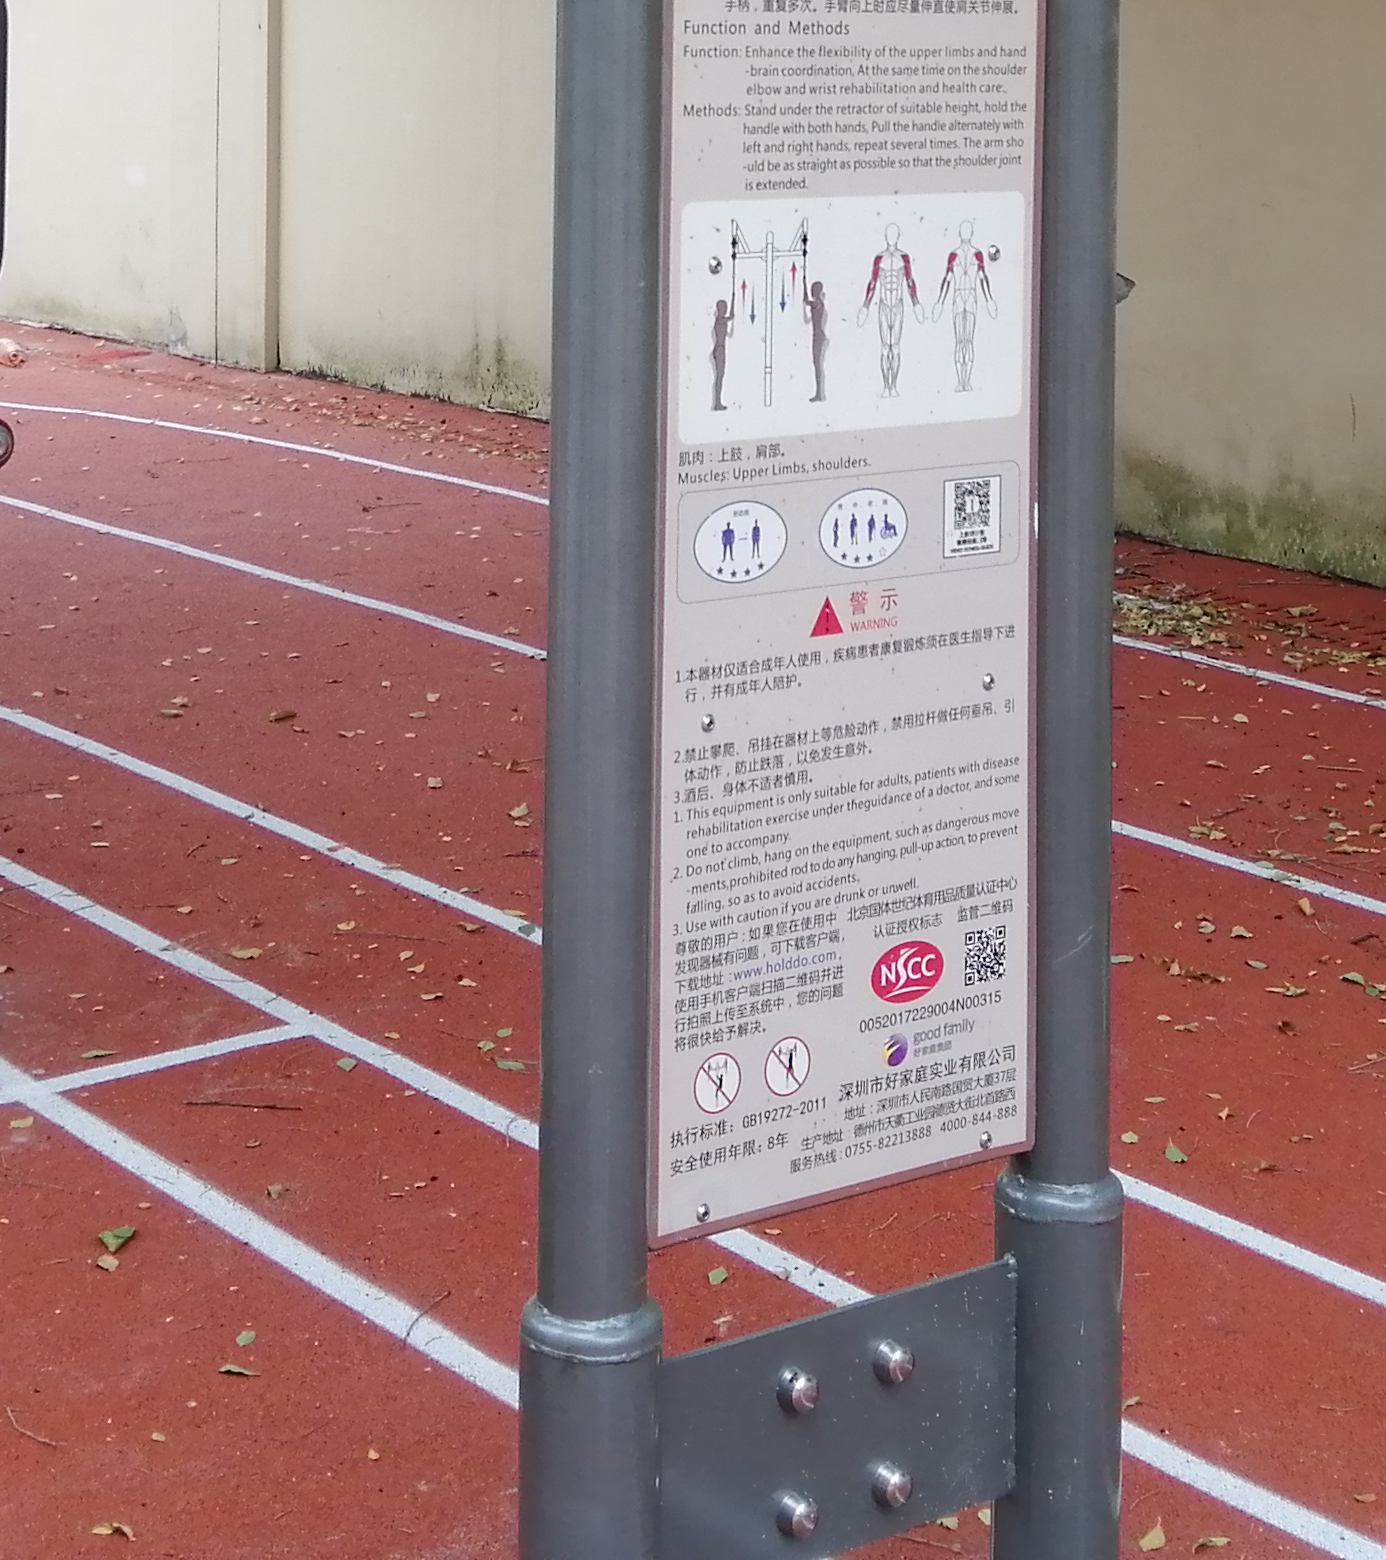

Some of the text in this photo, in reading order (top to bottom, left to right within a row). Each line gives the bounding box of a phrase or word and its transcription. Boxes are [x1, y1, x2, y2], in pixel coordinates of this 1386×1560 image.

[683, 19, 849, 35] Function and Methods
[683, 44, 1026, 60] Function: Enhance the flexibility of the upper limbs and hand
[857, 64, 870, 76] At
[871, 64, 888, 76] the
[891, 66, 919, 76] same
[921, 62, 945, 75] time
[946, 66, 960, 75] on
[962, 63, 980, 75] the
[981, 63, 1027, 75] shoulder
[746, 82, 781, 95] elbow
[784, 82, 805, 95] and
[808, 82, 836, 94] wrist
[839, 81, 916, 94] rehabilitation
[918, 81, 939, 93] and
[942, 81, 976, 93] health
[682, 102, 740, 117] Methods:
[744, 103, 776, 116] Stand
[779, 102, 812, 115] under
[815, 102, 833, 115] the
[836, 102, 883, 115] retractor
[886, 101, 897, 114] of
[900, 100, 942, 114] suitable
[984, 100, 1007, 112] hold
[1010, 100, 1027, 112] the
[742, 122, 779, 134] handle
[781, 121, 805, 134] with
[807, 120, 832, 133] both
[871, 120, 890, 132] Pull
[892, 120, 909, 132] the
[911, 119, 946, 132] handle
[948, 118, 1000, 133] alternately
[1002, 118, 1023, 130] with
[742, 140, 761, 153] left
[763, 140, 784, 153] and
[787, 139, 813, 156] right
[853, 139, 887, 154] repeat
[890, 137, 926, 150] several
[962, 136, 981, 148] The
[983, 138, 1003, 148] arm
[1005, 135, 1024, 148] sho
[766, 159, 780, 171] be
[782, 161, 794, 171] as
[796, 157, 837, 173] straight
[839, 160, 851, 169] as
[853, 155, 896, 172] possible
[898, 158, 910, 168] so
[912, 155, 932, 167] that
[934, 154, 951, 167] the
[954, 154, 997, 167] shoulder
[998, 153, 1021, 168] joint
[744, 178, 753, 190] is
[677, 456, 871, 484] Muscles: Upper Limbs, shoulders.
[849, 615, 897, 632] WARNING
[686, 806, 709, 820] This
[712, 796, 773, 817] equipment
[776, 793, 785, 805] is
[787, 788, 811, 804] only
[814, 781, 856, 799] suitable
[859, 778, 874, 791] for
[914, 766, 955, 785] patients
[958, 760, 980, 774] with
[982, 756, 1019, 770] disease
[957, 898, 1013, 922] 监管二维码
[873, 912, 942, 938] 认证授权标志
[859, 989, 1001, 1033] 0052017229004N00315
[913, 1018, 975, 1045] good family
[838, 1044, 1015, 1102] 深圳市好家庭实业有限公司
[939, 1104, 1017, 1132] 4000-844-888
